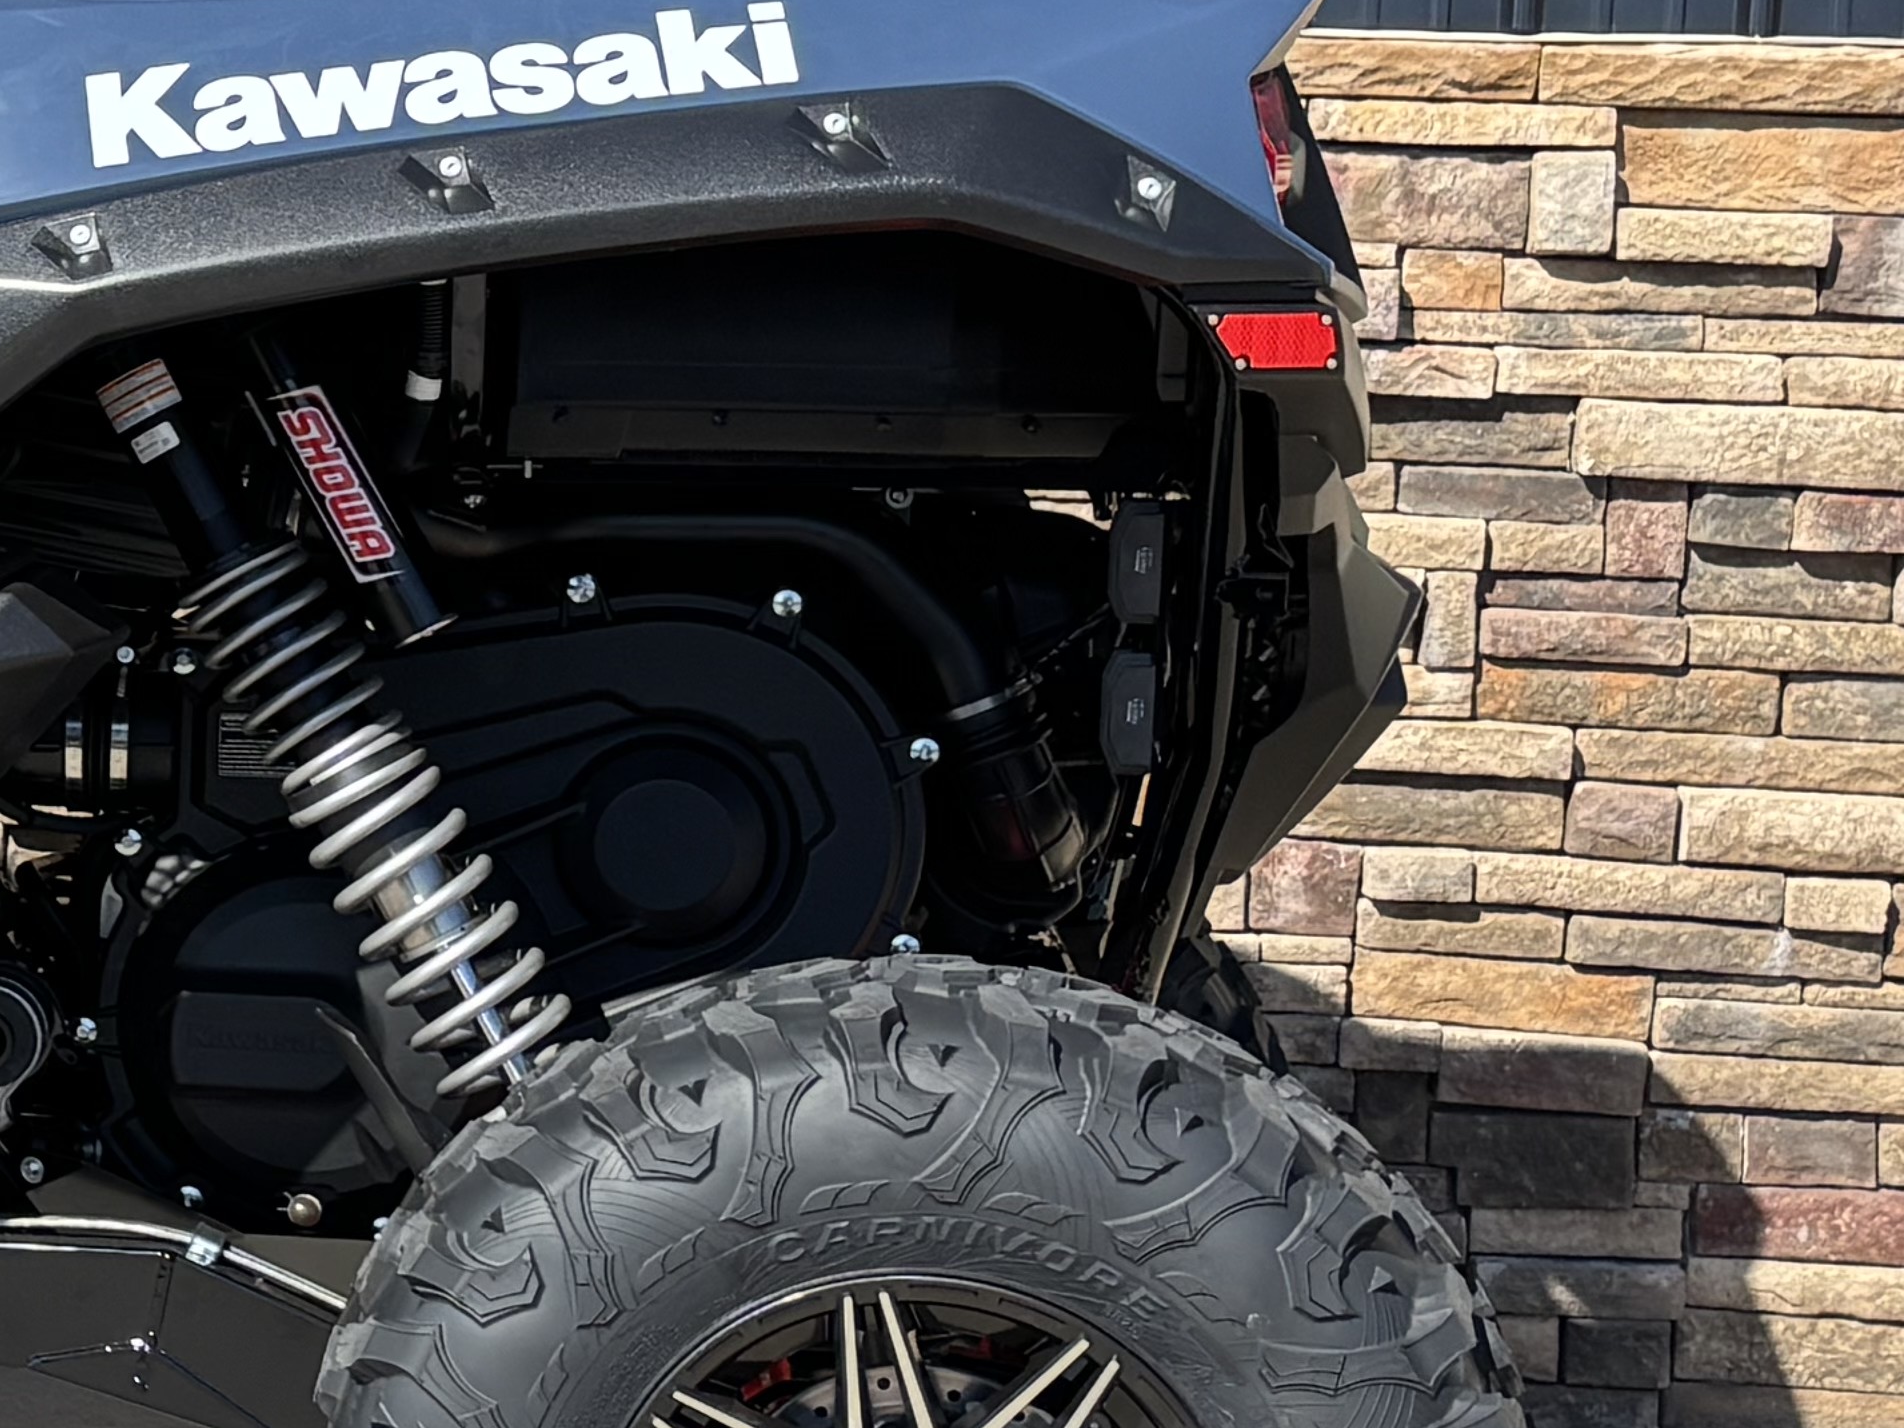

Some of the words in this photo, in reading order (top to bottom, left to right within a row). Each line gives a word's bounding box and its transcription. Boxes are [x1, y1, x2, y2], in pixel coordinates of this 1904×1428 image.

[85, 1, 799, 168] Kawasaki
[277, 406, 395, 563] SHOWA
[186, 1022, 336, 1054] Kawasak
